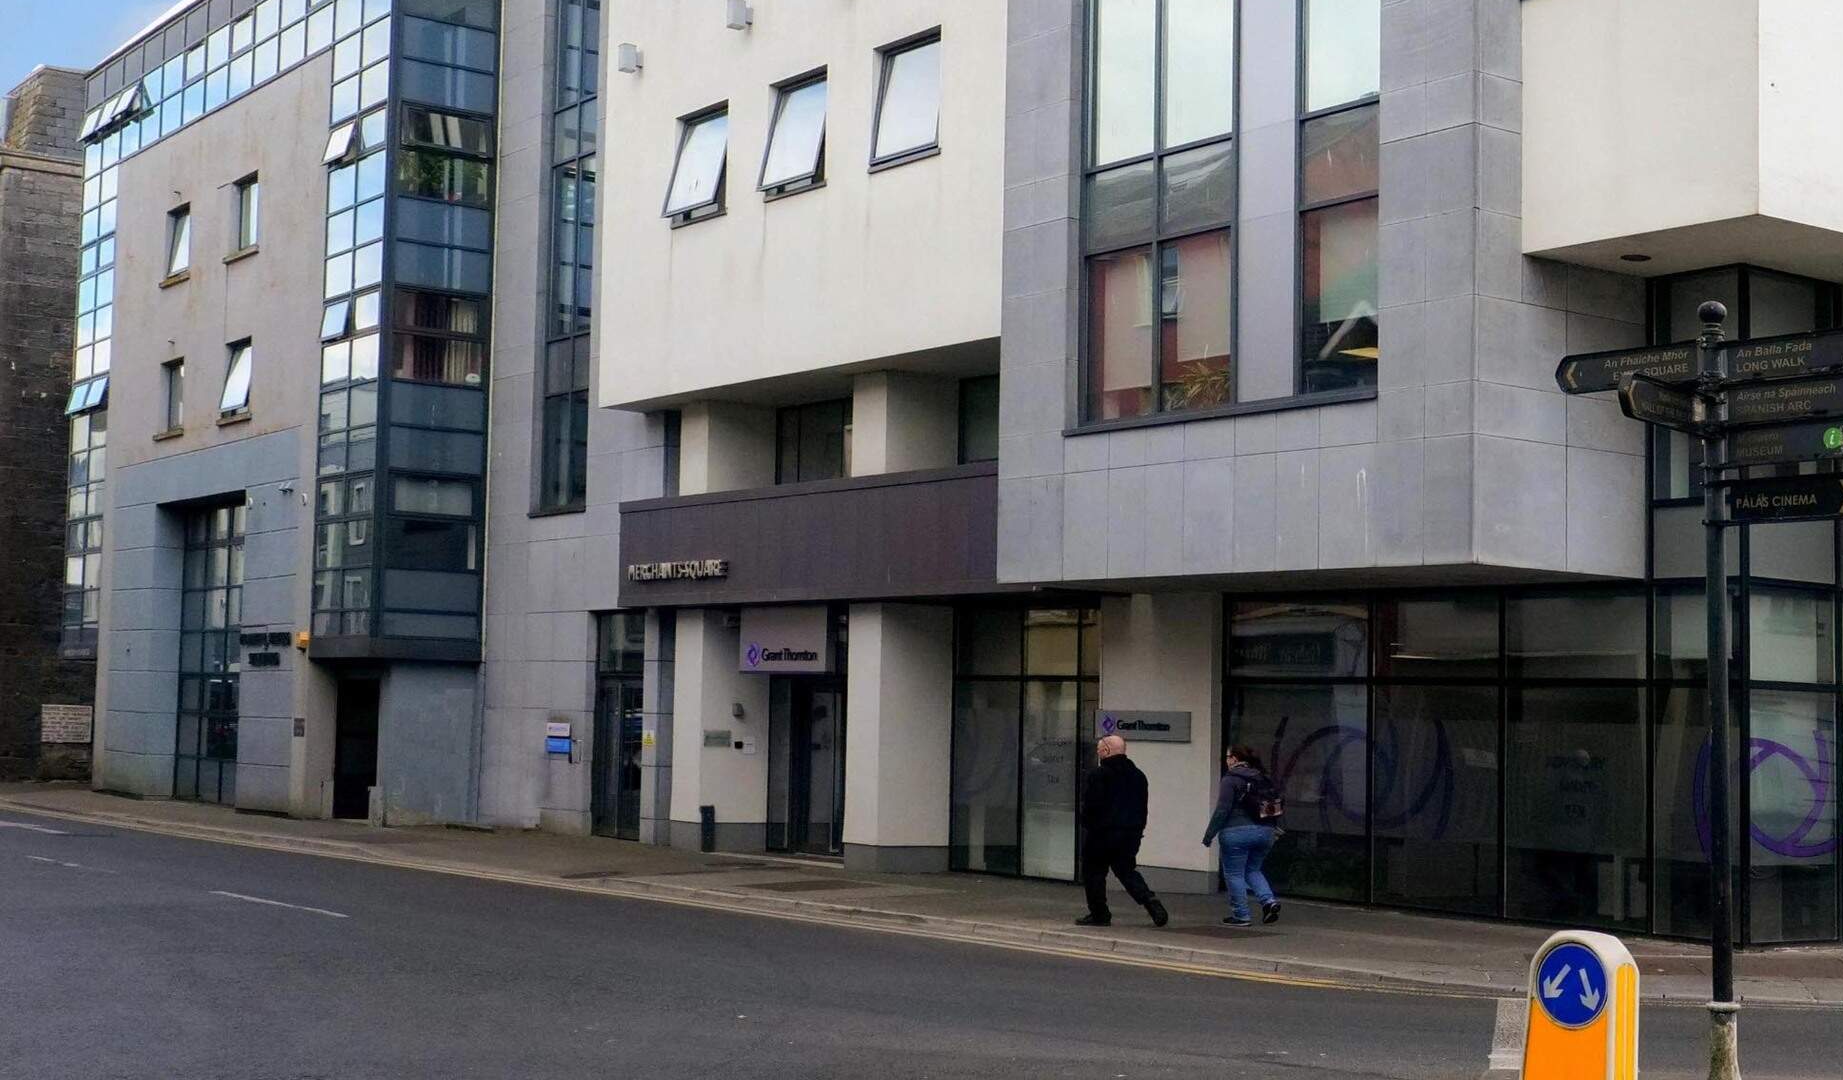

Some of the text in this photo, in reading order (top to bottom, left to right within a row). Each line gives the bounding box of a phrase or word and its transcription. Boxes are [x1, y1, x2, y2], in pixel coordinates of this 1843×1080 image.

[1645, 362, 1689, 377] SQUARE
[1736, 356, 1805, 373] LONG WALK
[1772, 493, 1817, 507] CINEMA
[627, 559, 728, 581] MERCHANTS SQUARE
[761, 647, 818, 661] Grant Thornton
